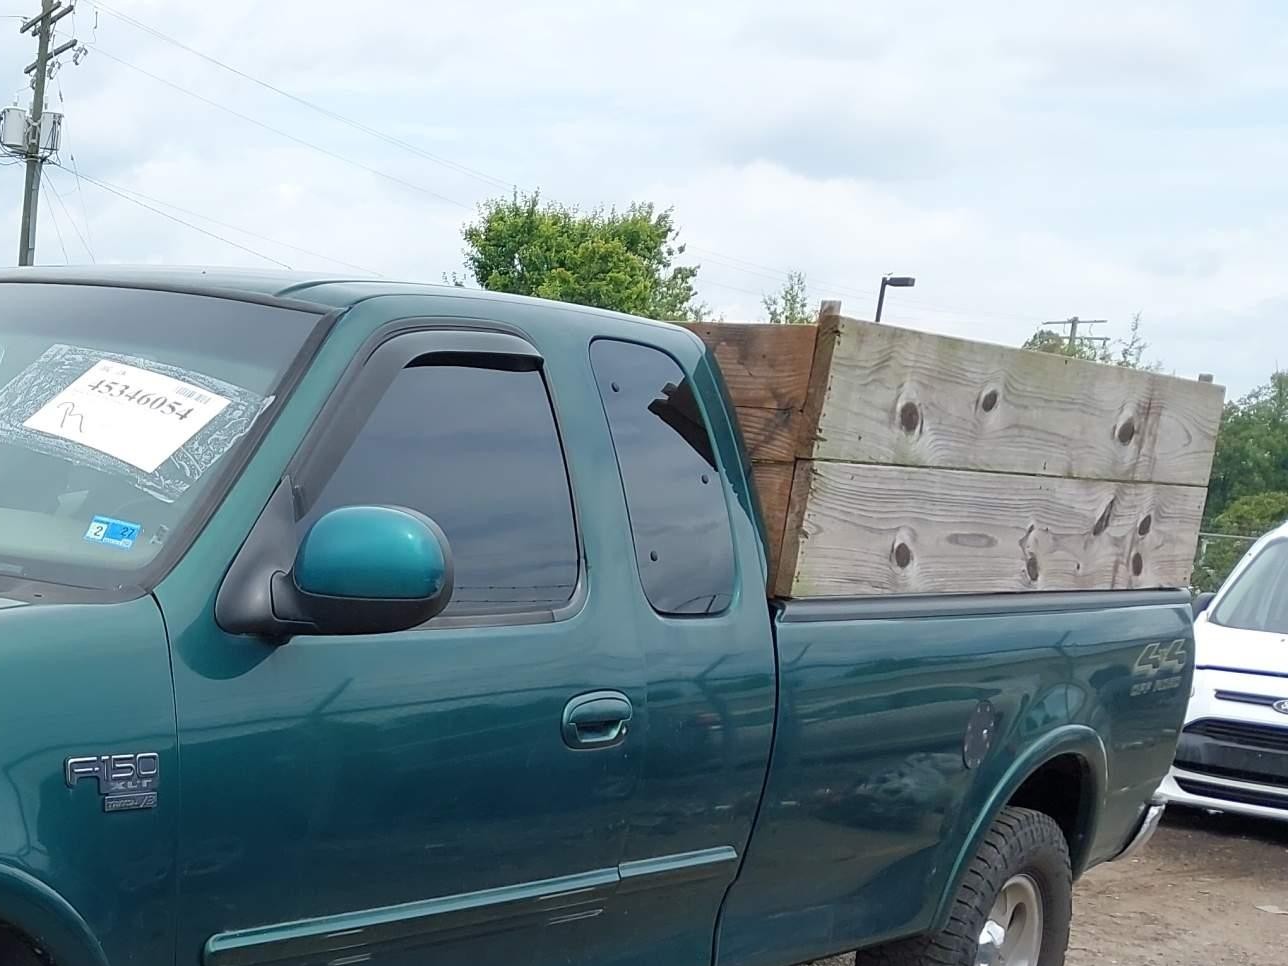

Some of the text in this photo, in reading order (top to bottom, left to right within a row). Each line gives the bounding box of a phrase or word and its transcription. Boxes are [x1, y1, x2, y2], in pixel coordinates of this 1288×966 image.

[88, 379, 195, 421] 45346054
[93, 525, 135, 538] 2 27
